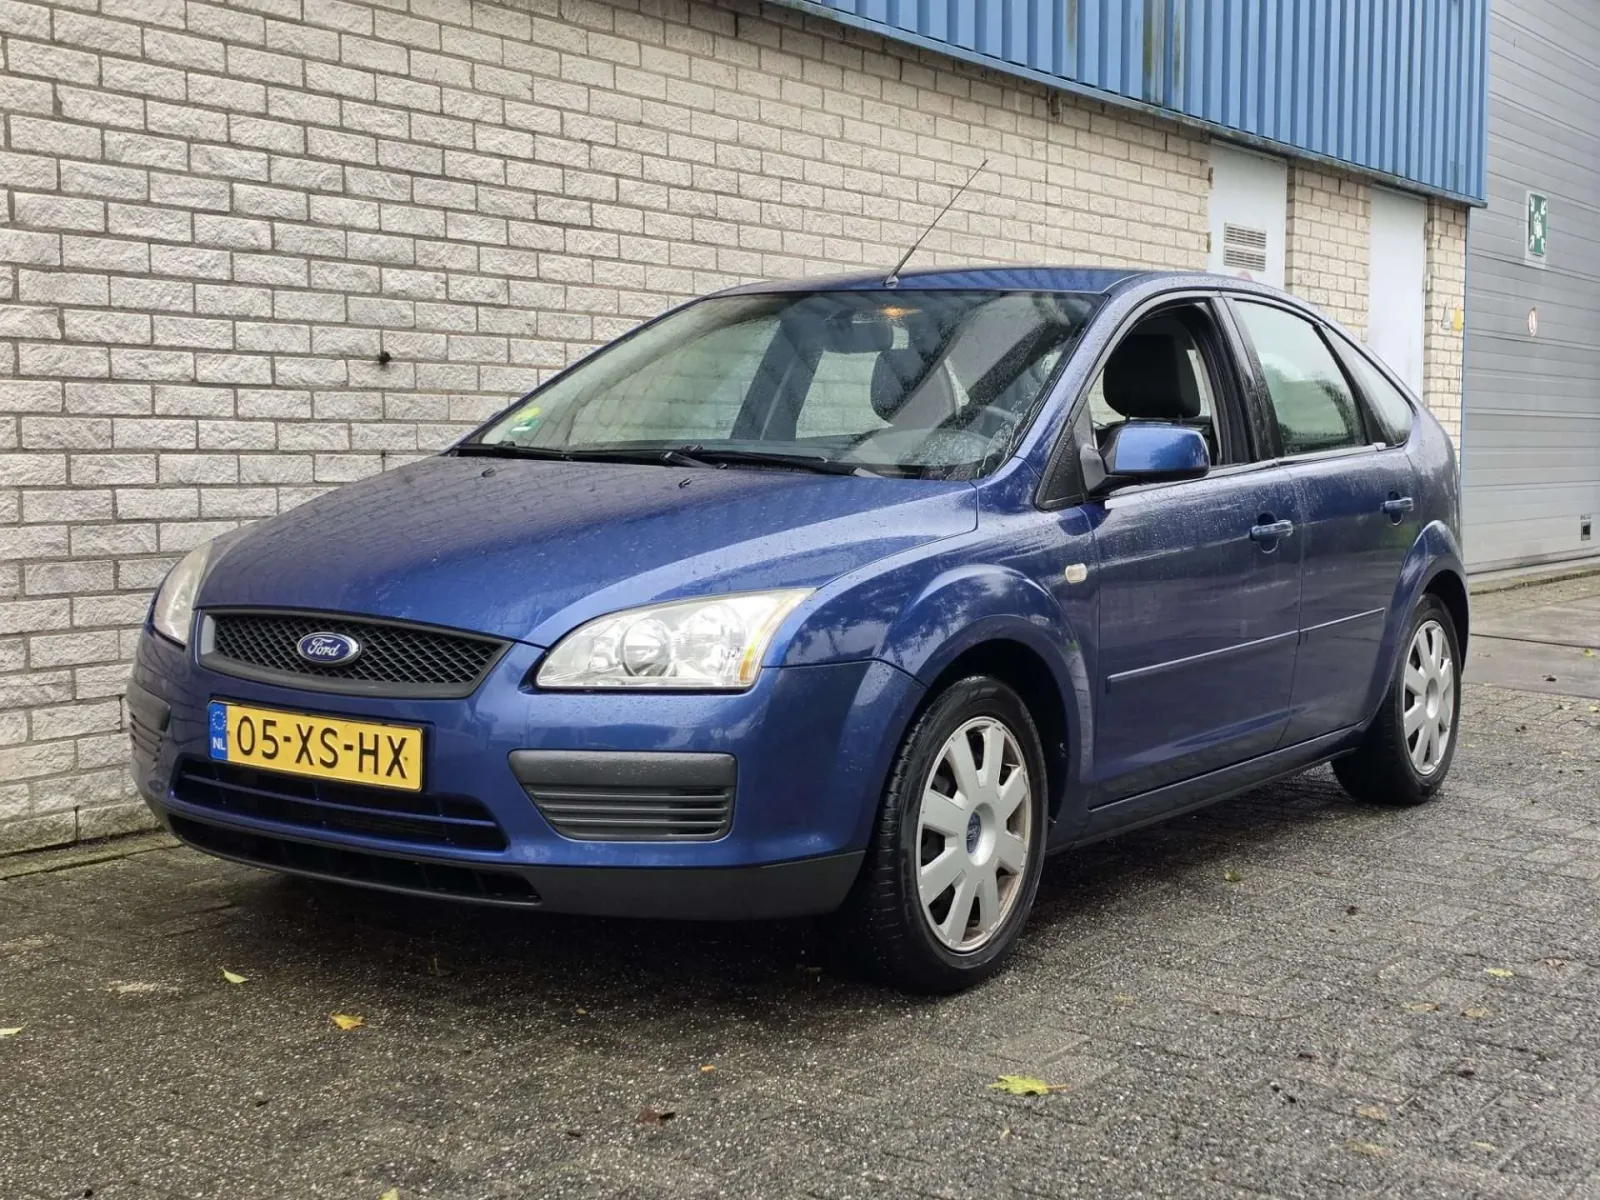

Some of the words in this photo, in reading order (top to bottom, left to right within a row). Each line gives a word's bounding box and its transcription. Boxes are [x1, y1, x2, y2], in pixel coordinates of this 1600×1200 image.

[307, 637, 340, 656] Ford
[213, 737, 226, 751] NL
[237, 715, 408, 780] 05-XS-HX
